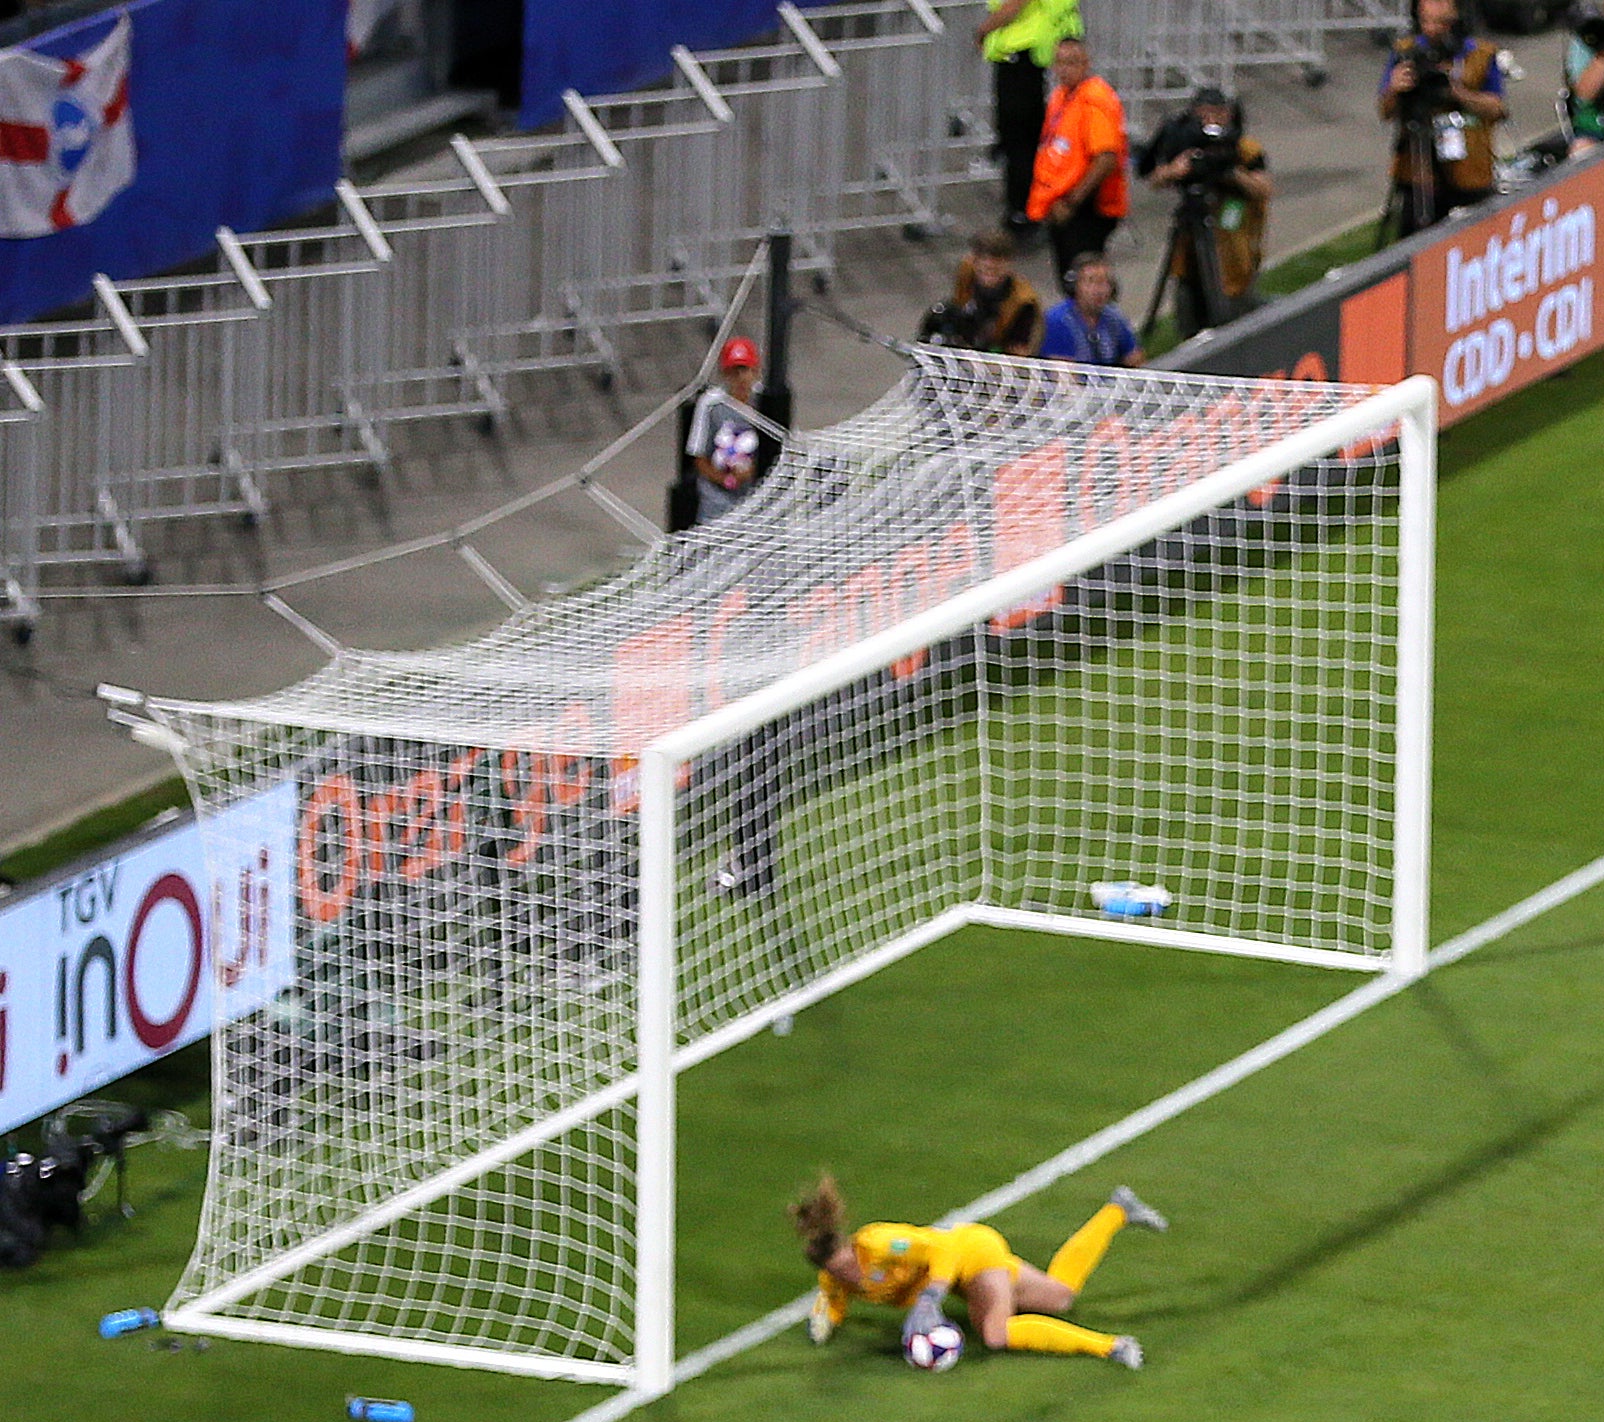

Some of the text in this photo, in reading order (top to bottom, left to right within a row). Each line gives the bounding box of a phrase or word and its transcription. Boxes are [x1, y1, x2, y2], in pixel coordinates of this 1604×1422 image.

[1445, 197, 1596, 334] Intérim
[1443, 318, 1516, 406] CDD
[57, 859, 120, 933] TGV
